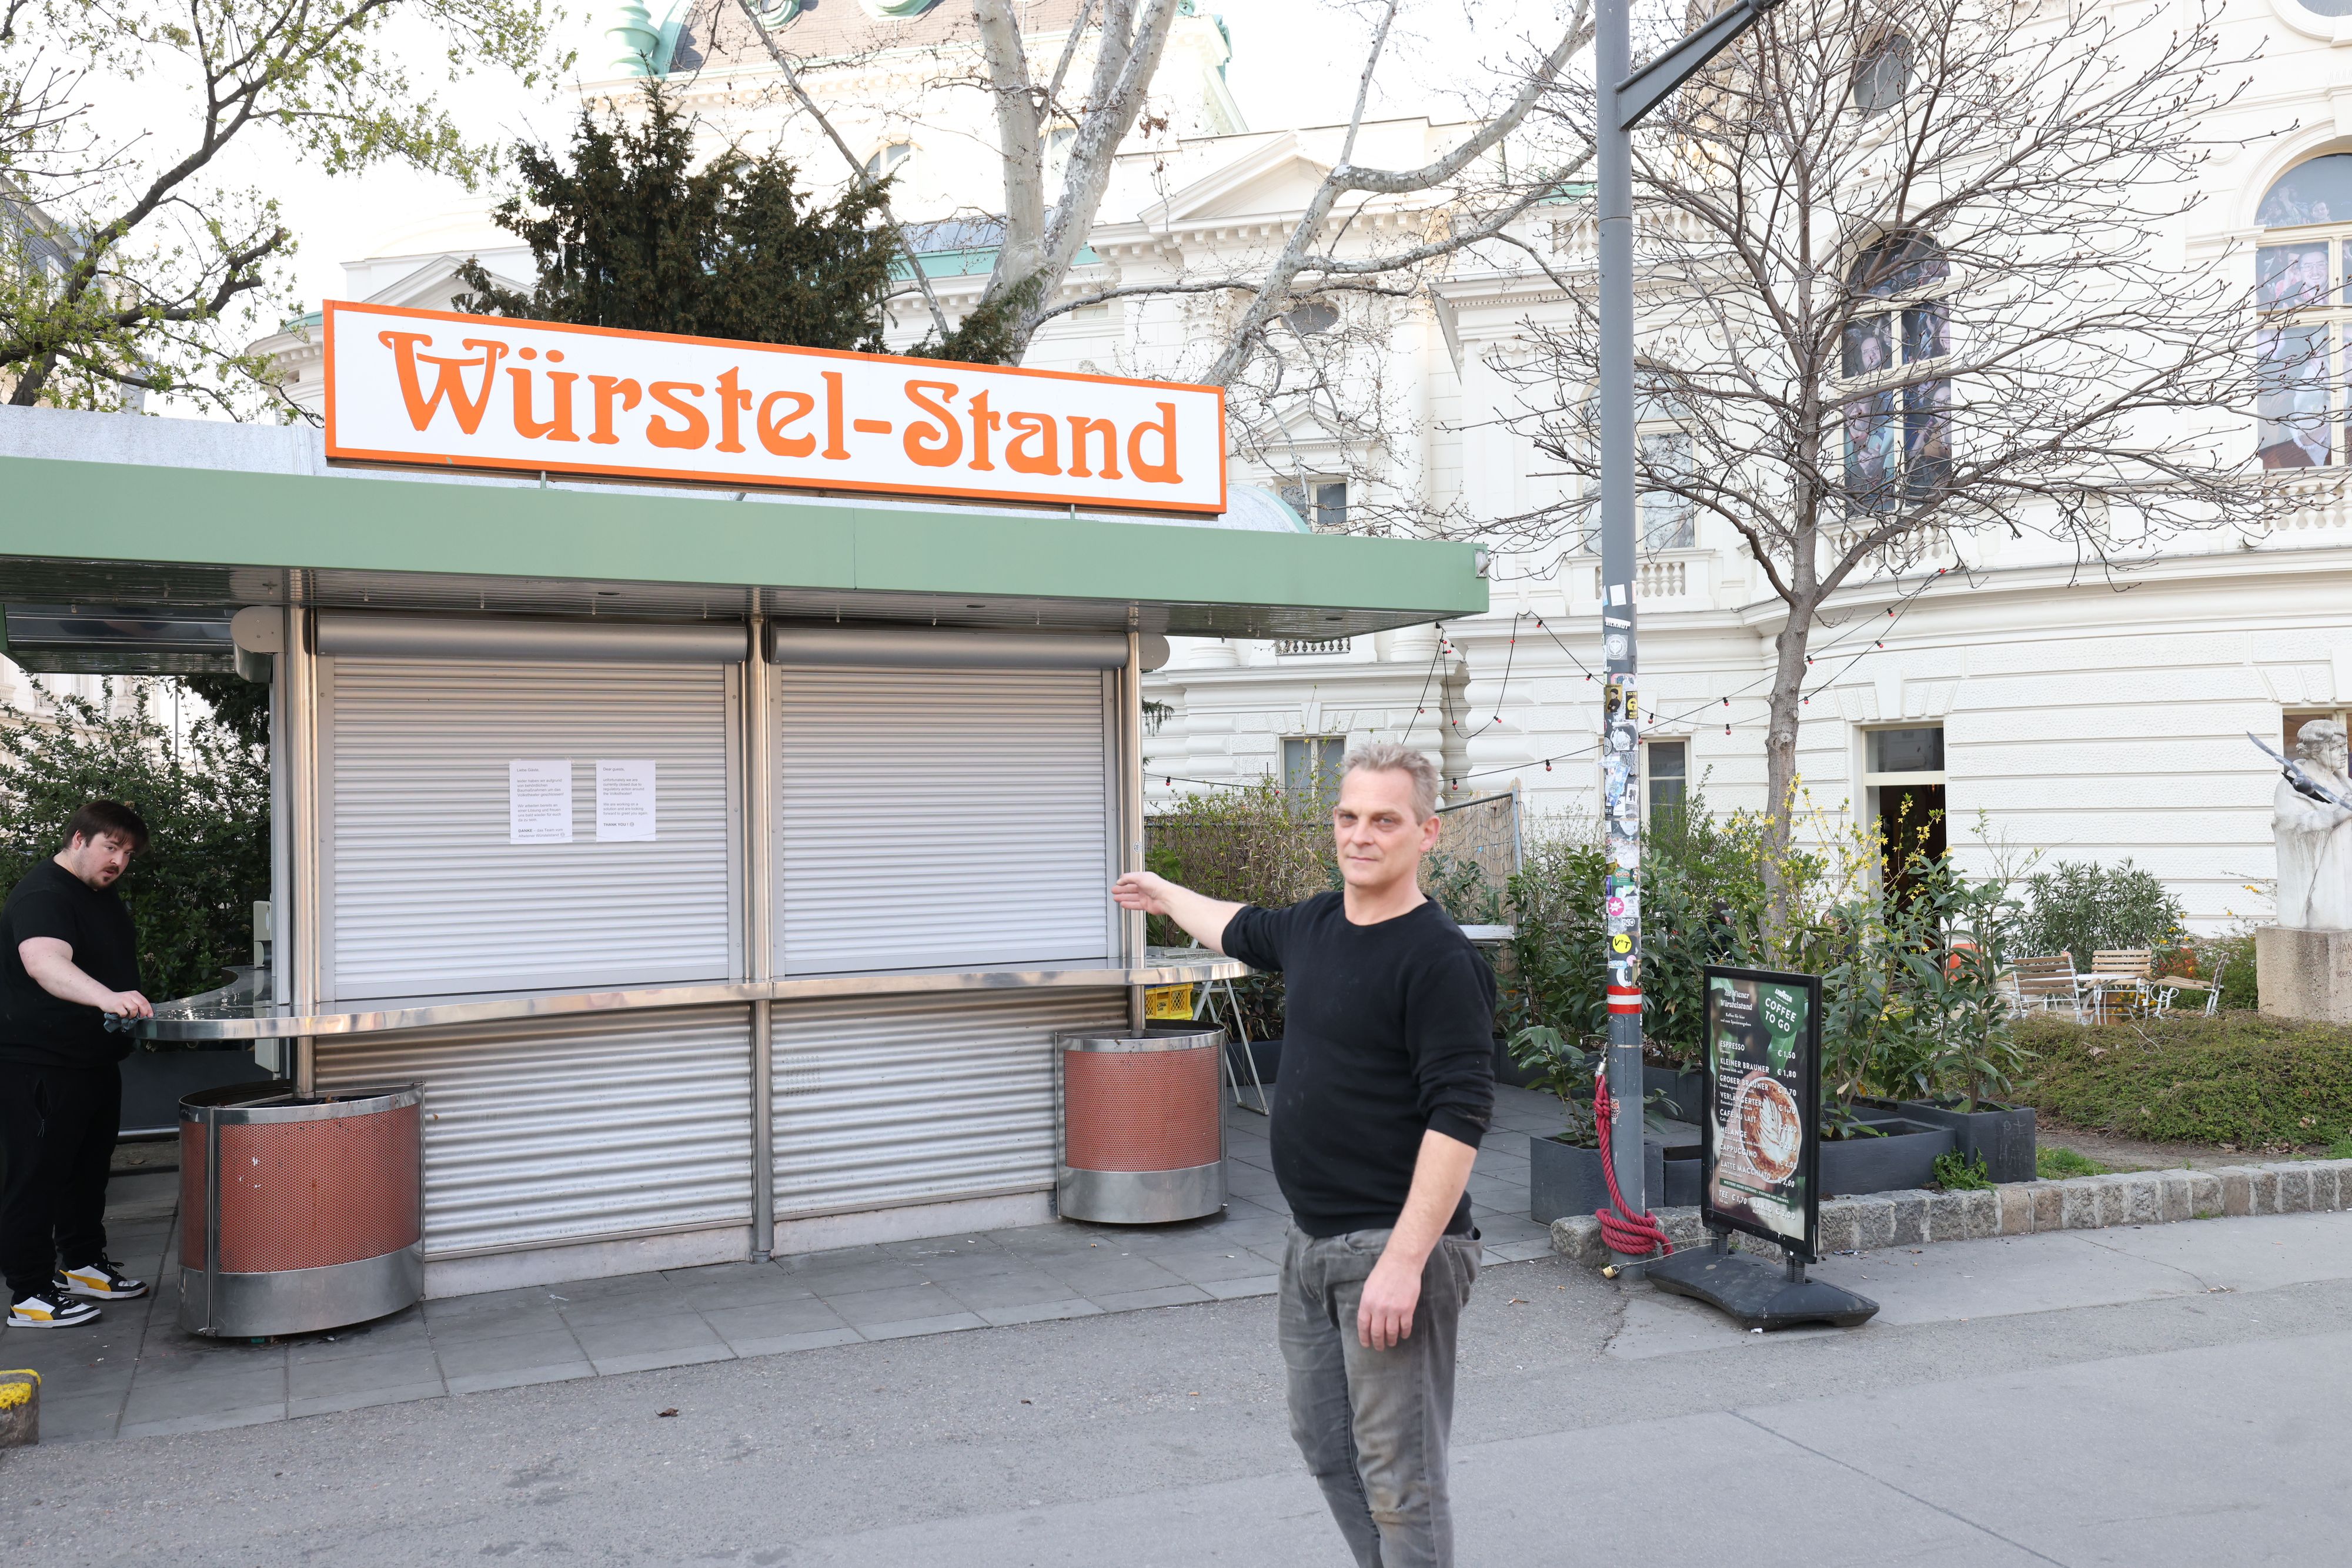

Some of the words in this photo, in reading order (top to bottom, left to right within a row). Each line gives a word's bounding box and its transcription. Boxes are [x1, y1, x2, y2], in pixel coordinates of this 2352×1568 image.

[378, 330, 1184, 484] Würstel-Stand
[1720, 999, 1752, 1011] Würstelstand
[1765, 998, 1797, 1022] COFFEE
[1765, 1011, 1776, 1024] TO
[1778, 1019, 1790, 1032] GO
[1720, 1041, 1745, 1051] ESPRESSO
[1783, 1051, 1796, 1059] 1,50
[1720, 1057, 1741, 1068] KLEINER
[1742, 1062, 1769, 1074] BRAUNER
[1783, 1069, 1796, 1079] 1,80
[1742, 1079, 1769, 1091] BRAUNER
[1720, 1091, 1763, 1108] VERLÄNGERTER
[1784, 1105, 1796, 1115] 1,70
[1719, 1108, 1734, 1118] CAFÉ
[1744, 1114, 1756, 1123] LAIT
[1785, 1124, 1797, 1134] 2,00
[1719, 1143, 1757, 1158] CAPPUCCINO
[1785, 1161, 1797, 1169] 2,00
[1785, 1142, 1796, 1151] 2,00
[1721, 1160, 1736, 1170] LATTE
[1737, 1165, 1770, 1179] MACCHIATO
[1783, 1179, 1795, 1188] 2,00
[1719, 1189, 1728, 1198] TEE
[1736, 1196, 1747, 1205] 1,70
[1782, 1210, 1795, 1219] 2,00
